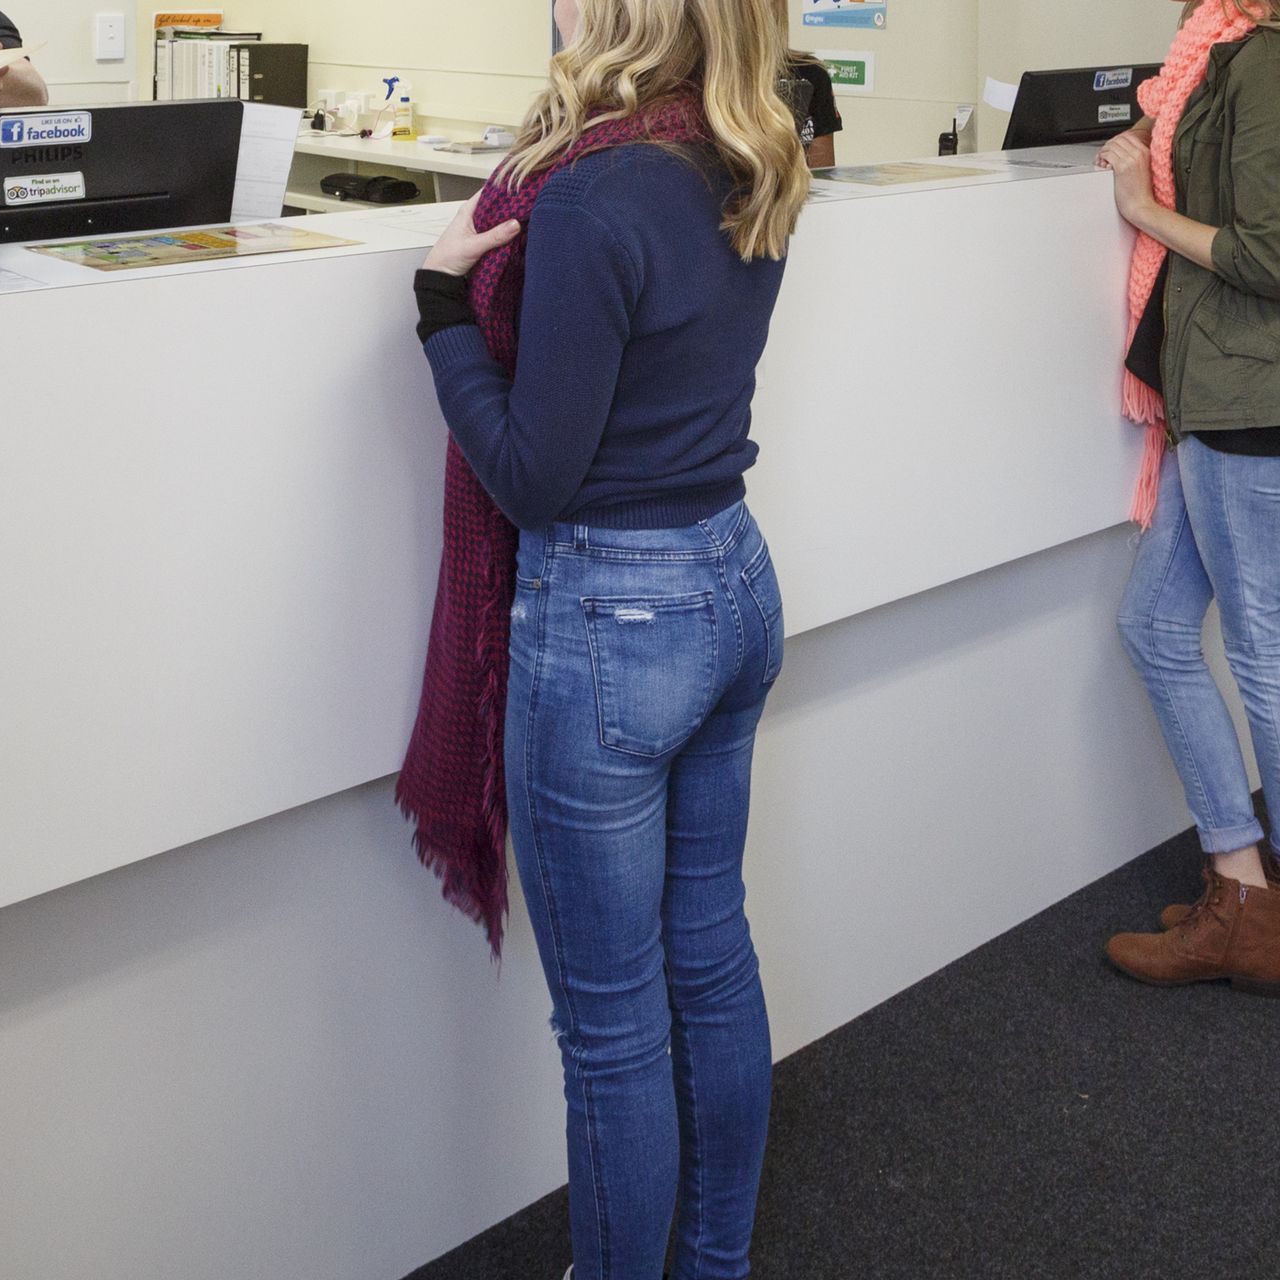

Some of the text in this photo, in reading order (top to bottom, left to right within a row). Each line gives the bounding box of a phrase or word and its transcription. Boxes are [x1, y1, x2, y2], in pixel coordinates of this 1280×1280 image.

[42, 118, 53, 126] LIKE
[27, 125, 85, 140] facebook
[11, 145, 83, 164] PHILIPS
[30, 185, 77, 197] tripadvisor
